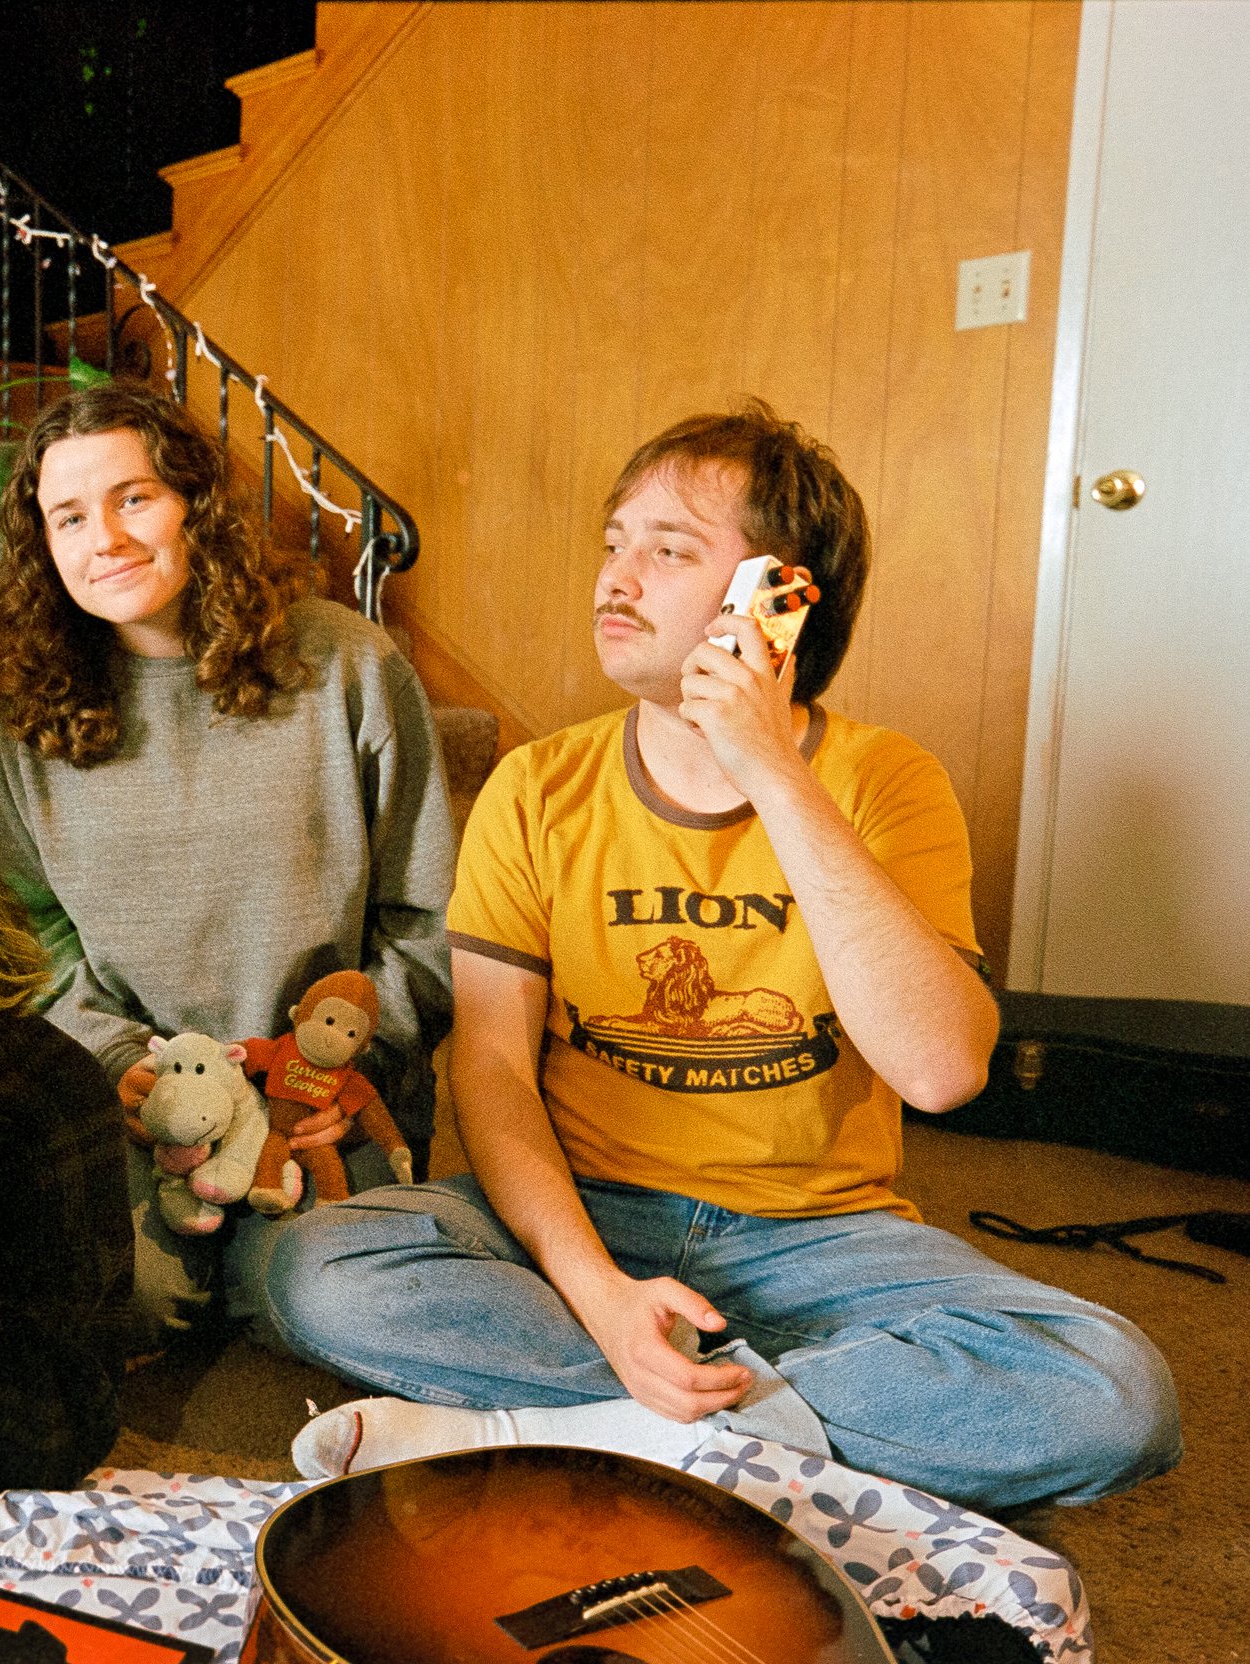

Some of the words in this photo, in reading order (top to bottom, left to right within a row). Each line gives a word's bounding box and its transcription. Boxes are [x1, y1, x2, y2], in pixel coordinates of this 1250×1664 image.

[606, 886, 796, 933] LION
[286, 1059, 338, 1086] Curious
[685, 1052, 816, 1087] MATCHES
[284, 1073, 331, 1098] George
